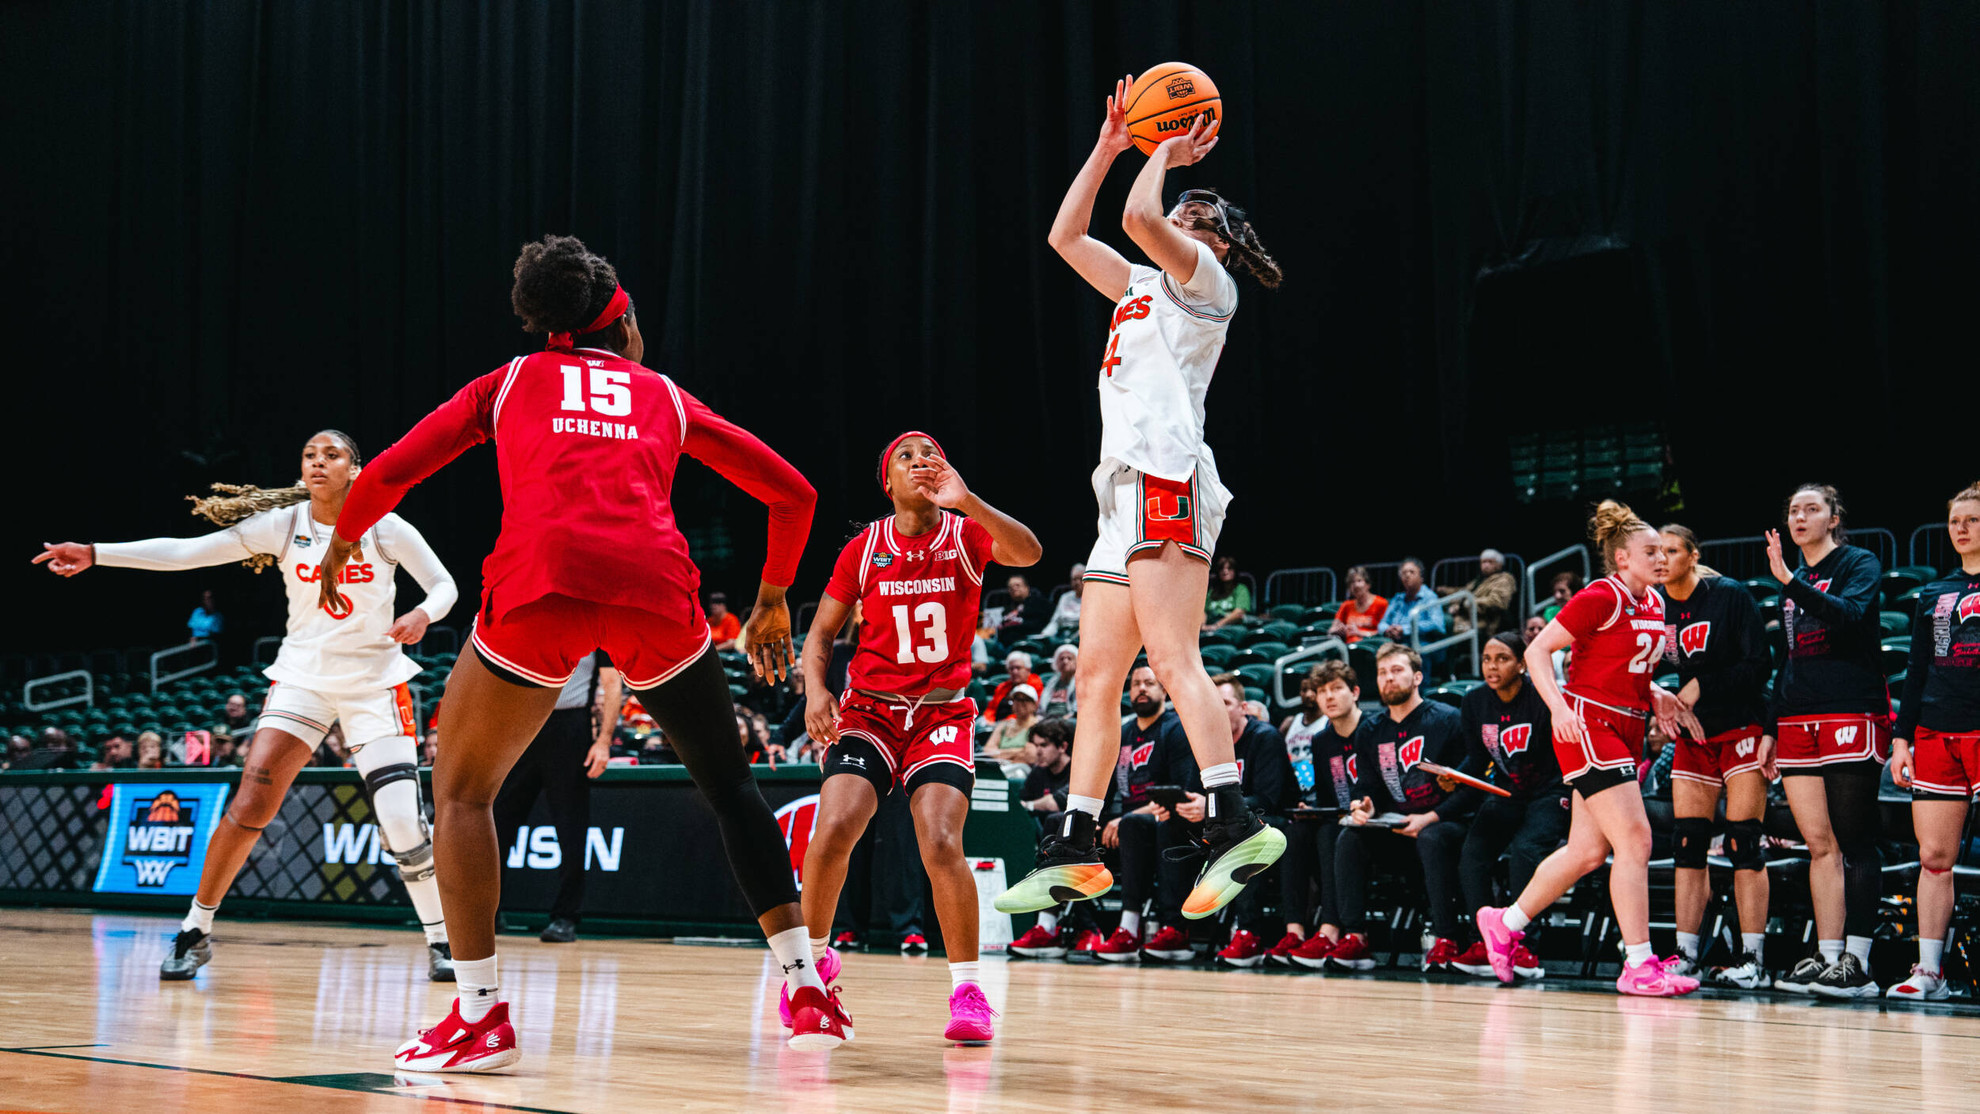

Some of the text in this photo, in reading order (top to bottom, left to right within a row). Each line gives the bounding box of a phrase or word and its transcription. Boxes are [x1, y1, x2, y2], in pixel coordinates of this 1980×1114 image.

[1155, 107, 1216, 132] Wlson
[560, 364, 632, 417] 15
[552, 417, 639, 440] UCHENNA
[1147, 496, 1190, 521] U
[879, 577, 956, 596] WISCONSIN
[892, 602, 949, 664] 13
[1679, 620, 1711, 658] W
[1628, 632, 1665, 674] 24
[929, 725, 958, 746] W
[1500, 722, 1532, 758] W
[1735, 736, 1756, 758] W
[1835, 725, 1858, 746] W
[1131, 740, 1155, 771] W
[1398, 735, 1425, 773] W
[128, 826, 194, 852] WBIT
